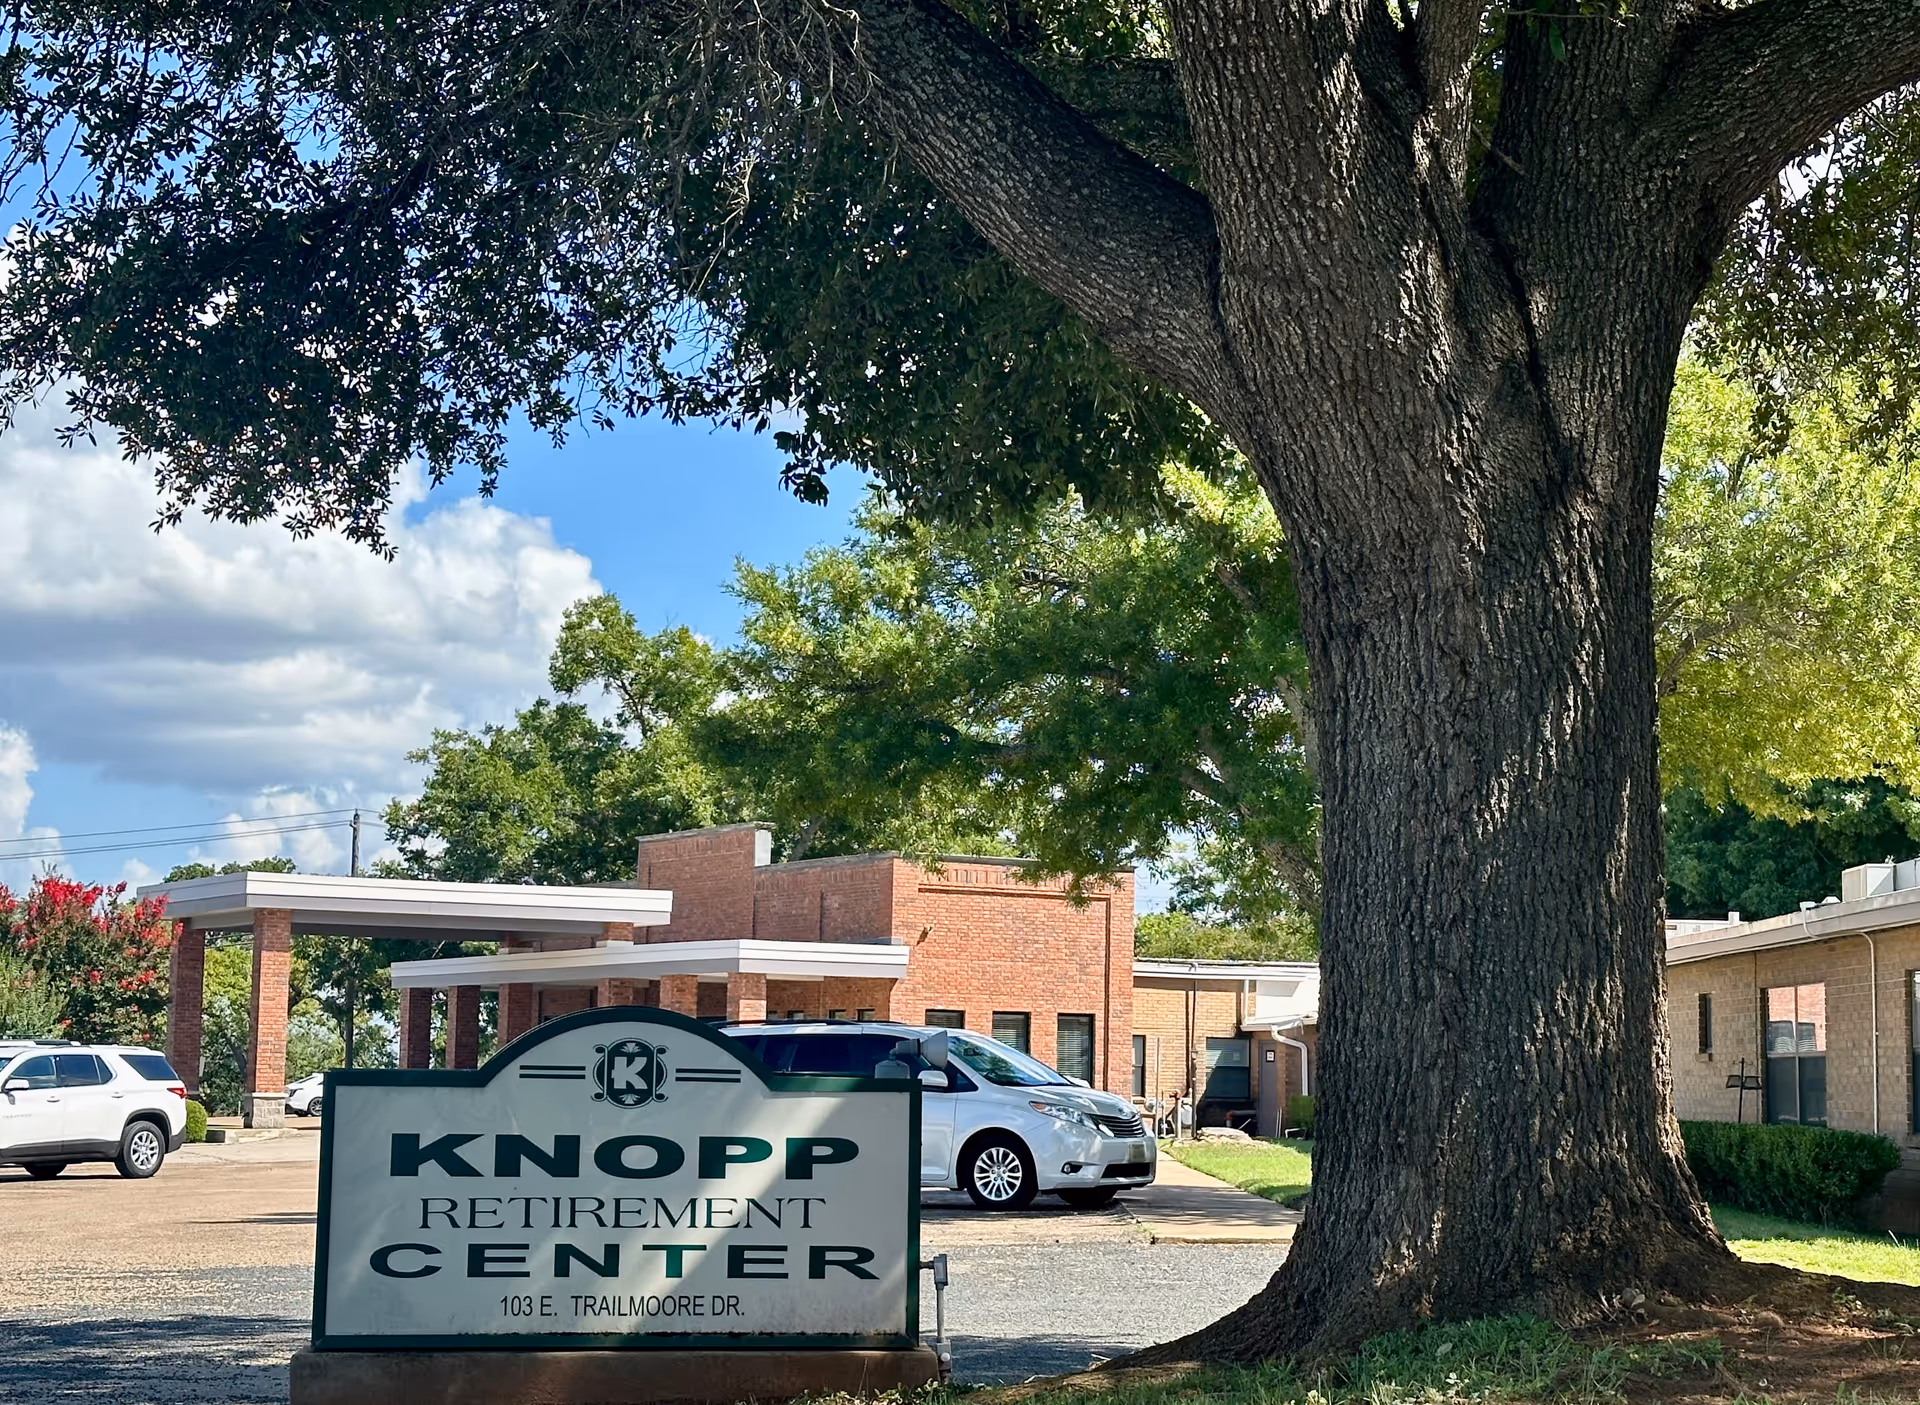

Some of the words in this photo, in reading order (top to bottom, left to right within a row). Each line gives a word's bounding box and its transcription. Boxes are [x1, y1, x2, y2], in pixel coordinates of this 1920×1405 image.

[390, 1133, 859, 1179] KNOPP
[418, 1197, 826, 1229] RETIREMENT
[369, 1243, 880, 1280] CENTER
[500, 1295, 534, 1318] 103
[541, 1295, 558, 1317] E.
[571, 1295, 705, 1318] TRAILMOORE
[711, 1295, 745, 1317] DR.
